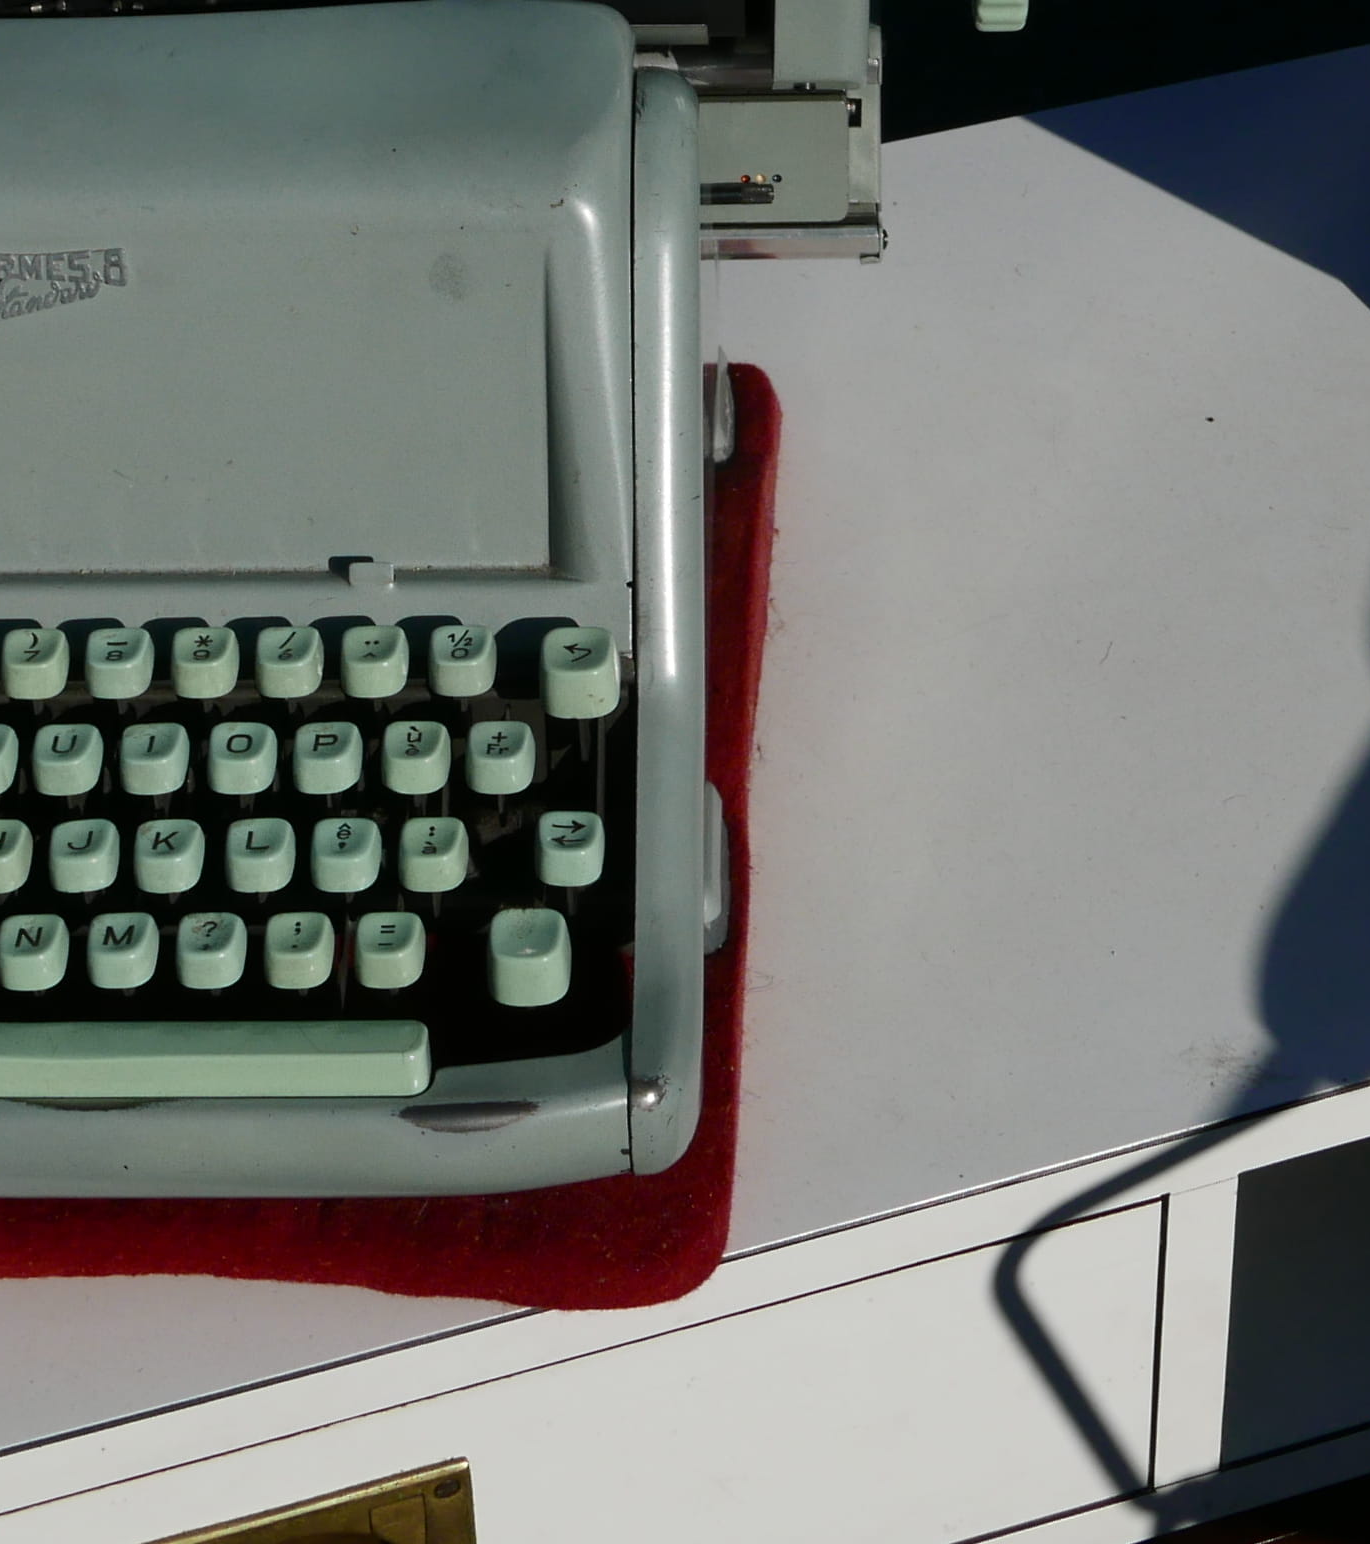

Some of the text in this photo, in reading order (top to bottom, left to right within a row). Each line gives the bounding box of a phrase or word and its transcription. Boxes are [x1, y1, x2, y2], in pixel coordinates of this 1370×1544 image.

[103, 247, 126, 287] 8
[23, 650, 41, 663] 7
[104, 649, 124, 662] 8
[192, 649, 211, 661] 9
[51, 734, 78, 755] U
[146, 735, 156, 753] I
[226, 734, 253, 754] O
[312, 733, 338, 752] P
[485, 743, 510, 755] Fr
[66, 830, 94, 852] J
[151, 831, 179, 851] K
[245, 830, 270, 851] L
[14, 926, 43, 948] N
[102, 924, 135, 946] M
[201, 920, 218, 938] ?
